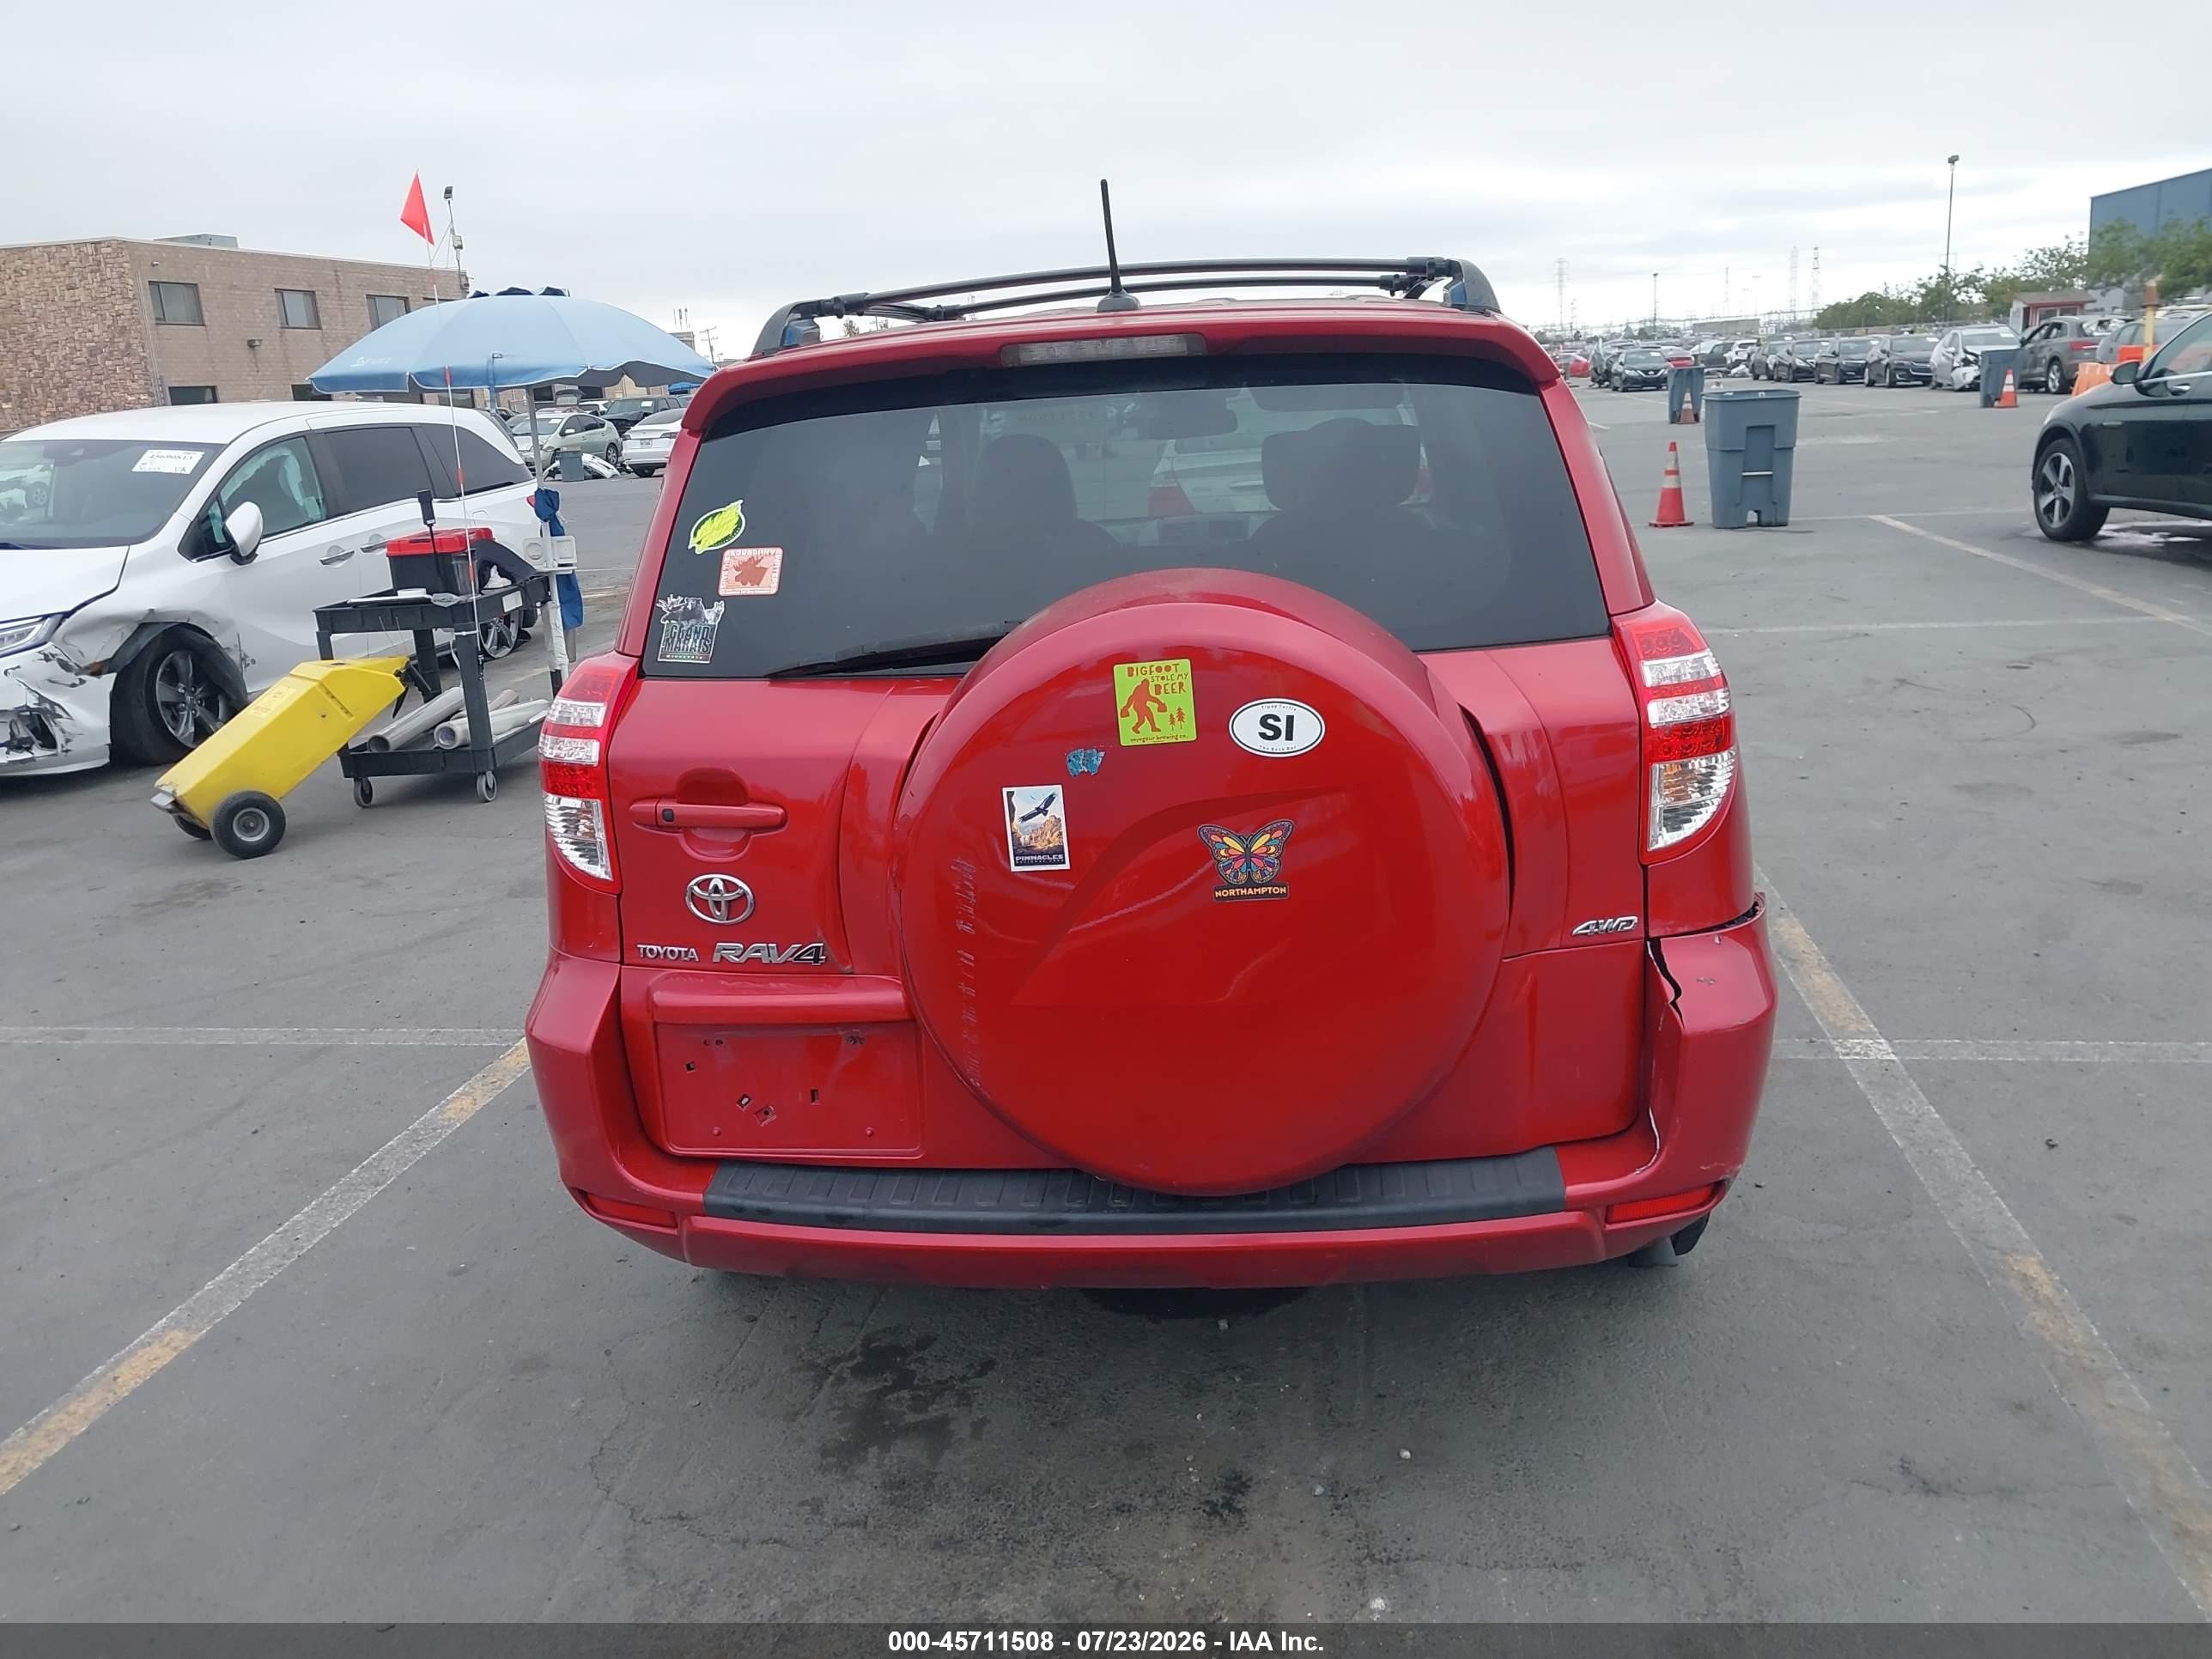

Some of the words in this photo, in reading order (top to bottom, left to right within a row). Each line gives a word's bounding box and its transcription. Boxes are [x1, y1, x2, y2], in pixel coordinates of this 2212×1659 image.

[1127, 663, 1180, 678] BIGFOOT
[1150, 673, 1175, 683] STOLE
[1176, 672, 1189, 681] MY
[1154, 681, 1187, 696] BEER
[1258, 713, 1295, 742] SI
[1015, 854, 1064, 862] PINNACLES
[1214, 885, 1287, 898] NORTHAMPTON
[1571, 915, 1638, 936] 4WD
[636, 944, 699, 963] TOYOTA
[712, 942, 827, 966] RAV4
